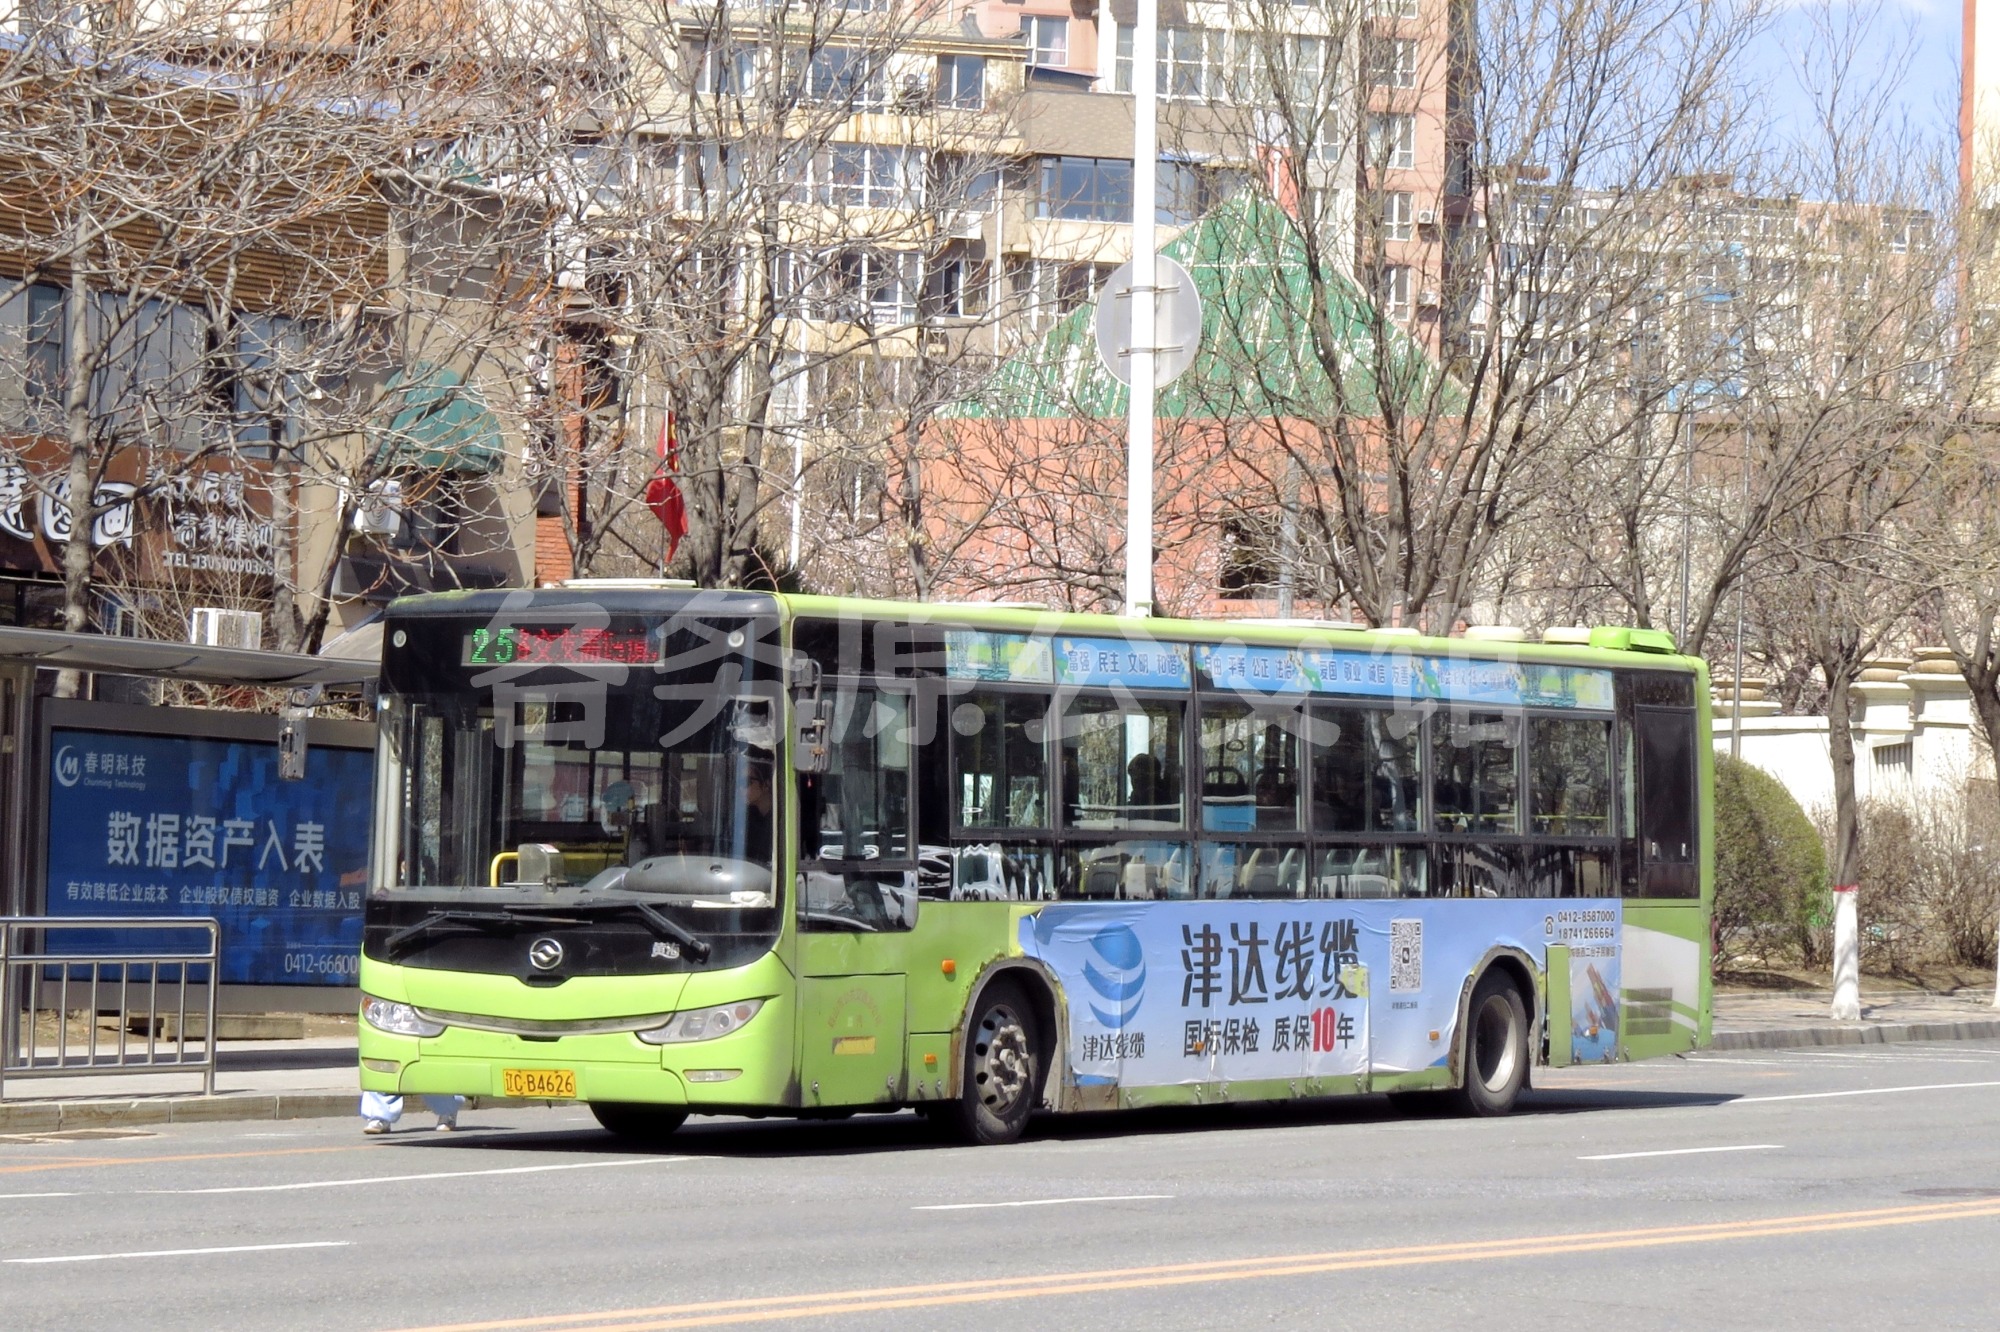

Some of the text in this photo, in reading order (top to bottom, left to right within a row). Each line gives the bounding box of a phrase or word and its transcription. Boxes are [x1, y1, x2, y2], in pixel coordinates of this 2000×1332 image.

[163, 551, 189, 567] TEL
[471, 627, 514, 663] 25
[1068, 650, 1091, 673] 富强
[1099, 651, 1120, 673] 民主
[1128, 653, 1149, 674] 文明
[1157, 654, 1180, 676] 和谐
[1204, 655, 1410, 686] 自由 平等 公正 法治 爱国 敬业 诚信 友善
[84, 752, 147, 777] 春明科技
[107, 811, 325, 873] 数据资产入表
[67, 881, 361, 910] 有效降低企业成本 企业股权债权融资 企业数据入股
[1558, 911, 1615, 922] 0412-8587000
[1558, 928, 1614, 939] 18741266664
[285, 953, 361, 974] 0412-66600
[651, 942, 680, 959] 黄海
[1180, 918, 1360, 1008] 津达线缆
[1082, 1032, 1145, 1061] 津达线缆
[1183, 1016, 1260, 1057] 国标保检
